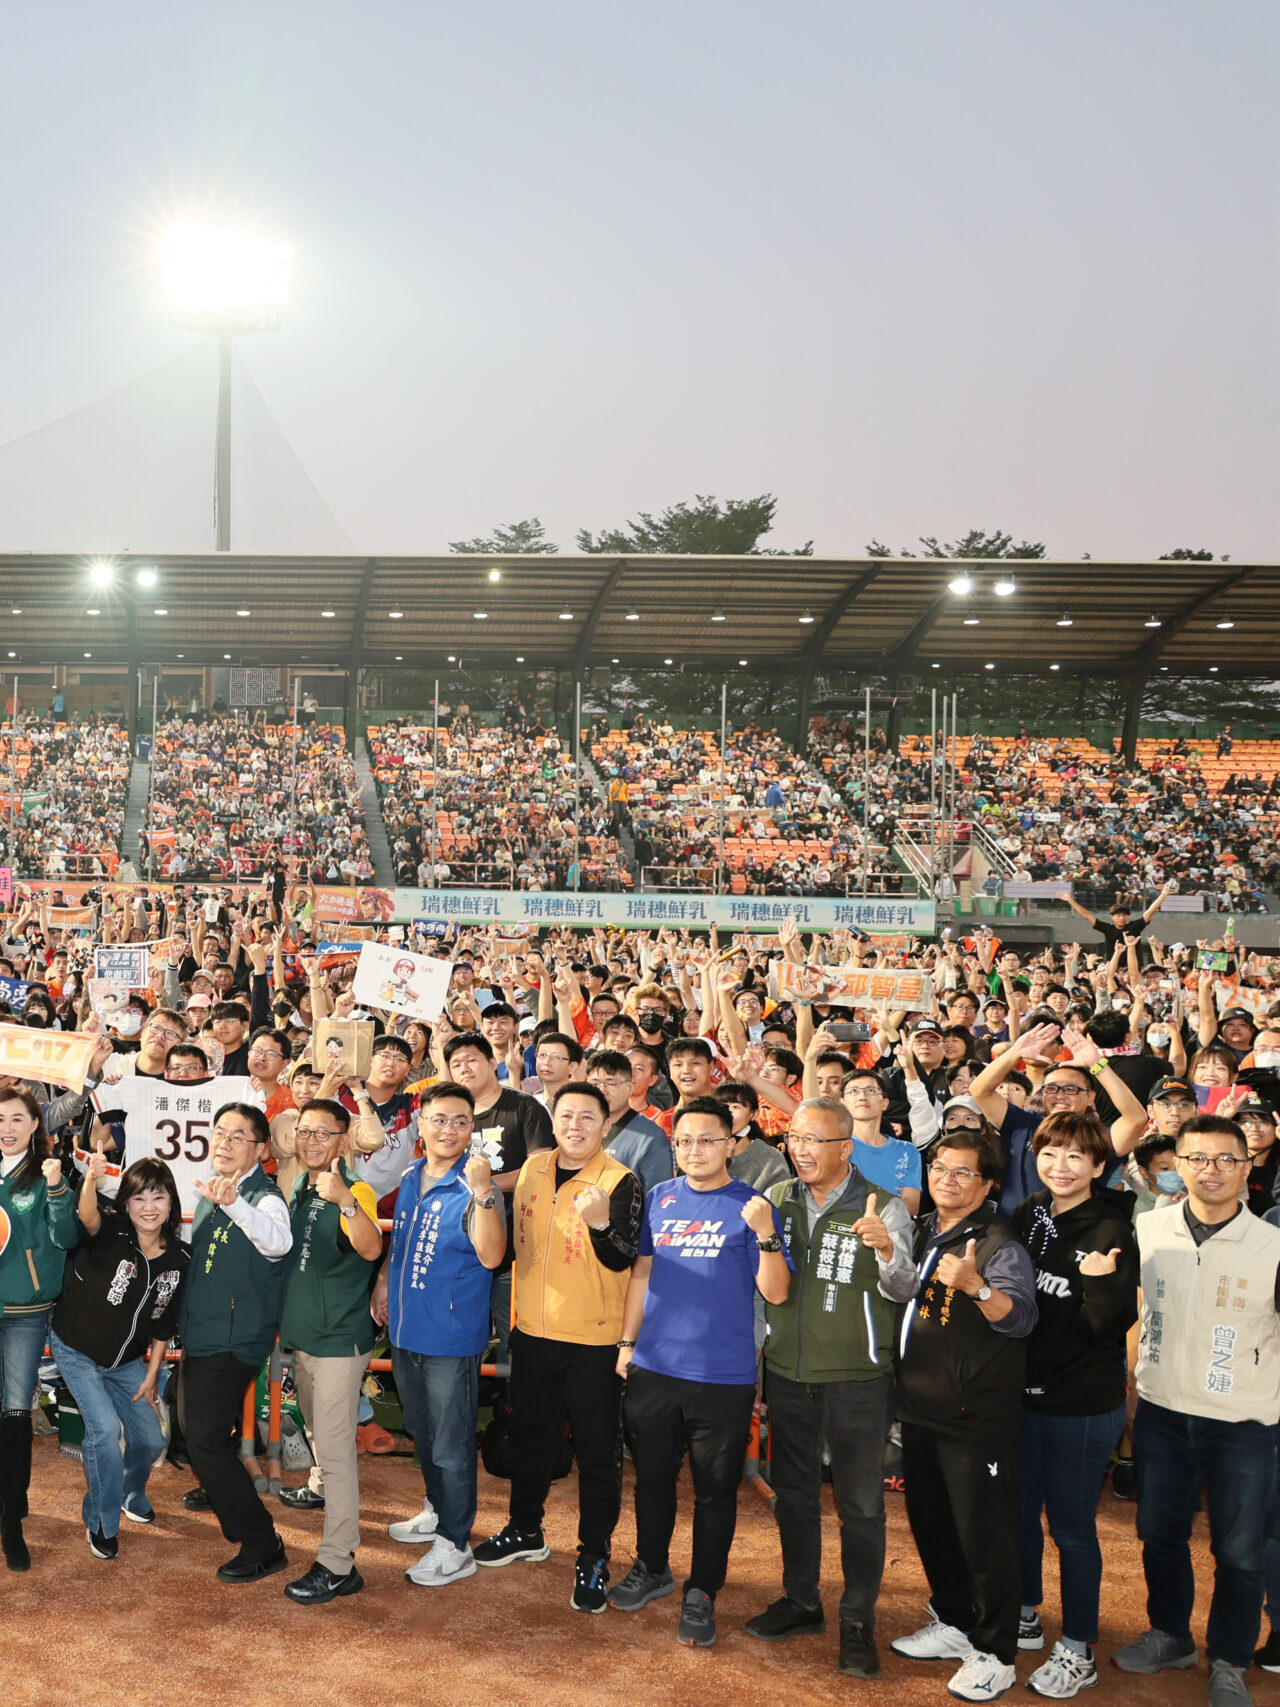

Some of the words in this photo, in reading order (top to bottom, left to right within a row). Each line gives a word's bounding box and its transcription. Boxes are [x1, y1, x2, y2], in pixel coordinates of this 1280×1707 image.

[420, 894, 501, 916] 瑞穗鮮乳
[523, 897, 604, 918] 瑞穗鮮乳
[626, 899, 707, 921] 瑞穗鮮乳
[730, 902, 810, 923] 瑞穗鮮乳
[833, 904, 915, 925] 瑞穗鮮乳
[104, 970, 139, 980] 他做到了
[844, 973, 922, 1000] 邱智呈
[155, 1096, 212, 1113] 潘傑楷
[154, 1118, 210, 1163] 35
[660, 1220, 724, 1233] TEAM
[422, 1230, 440, 1267] 謝龍介
[653, 1232, 727, 1249] TAIWAN
[835, 1236, 858, 1284] 林俊憲
[107, 1259, 135, 1306] 陳秋萍
[1207, 1325, 1237, 1394] 曾之婕
